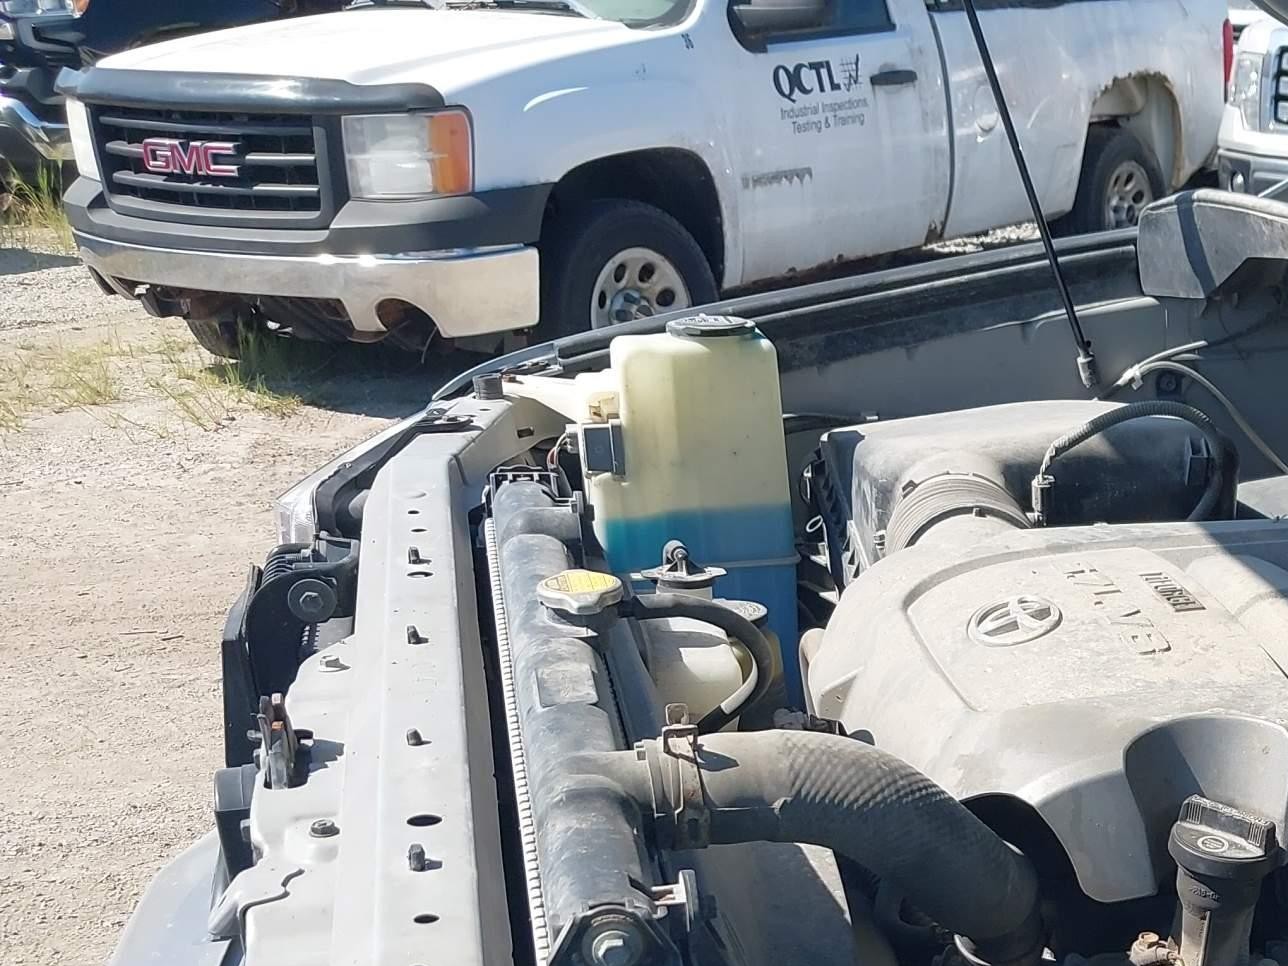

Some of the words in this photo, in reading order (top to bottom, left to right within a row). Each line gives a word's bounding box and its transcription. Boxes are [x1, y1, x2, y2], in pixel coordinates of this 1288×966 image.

[773, 60, 841, 104] QCTL
[780, 103, 820, 120] Industrial
[822, 98, 869, 112] Inspections
[792, 120, 822, 134] Testing
[824, 116, 831, 128] &
[833, 112, 865, 127] Training
[143, 138, 241, 176] GMC
